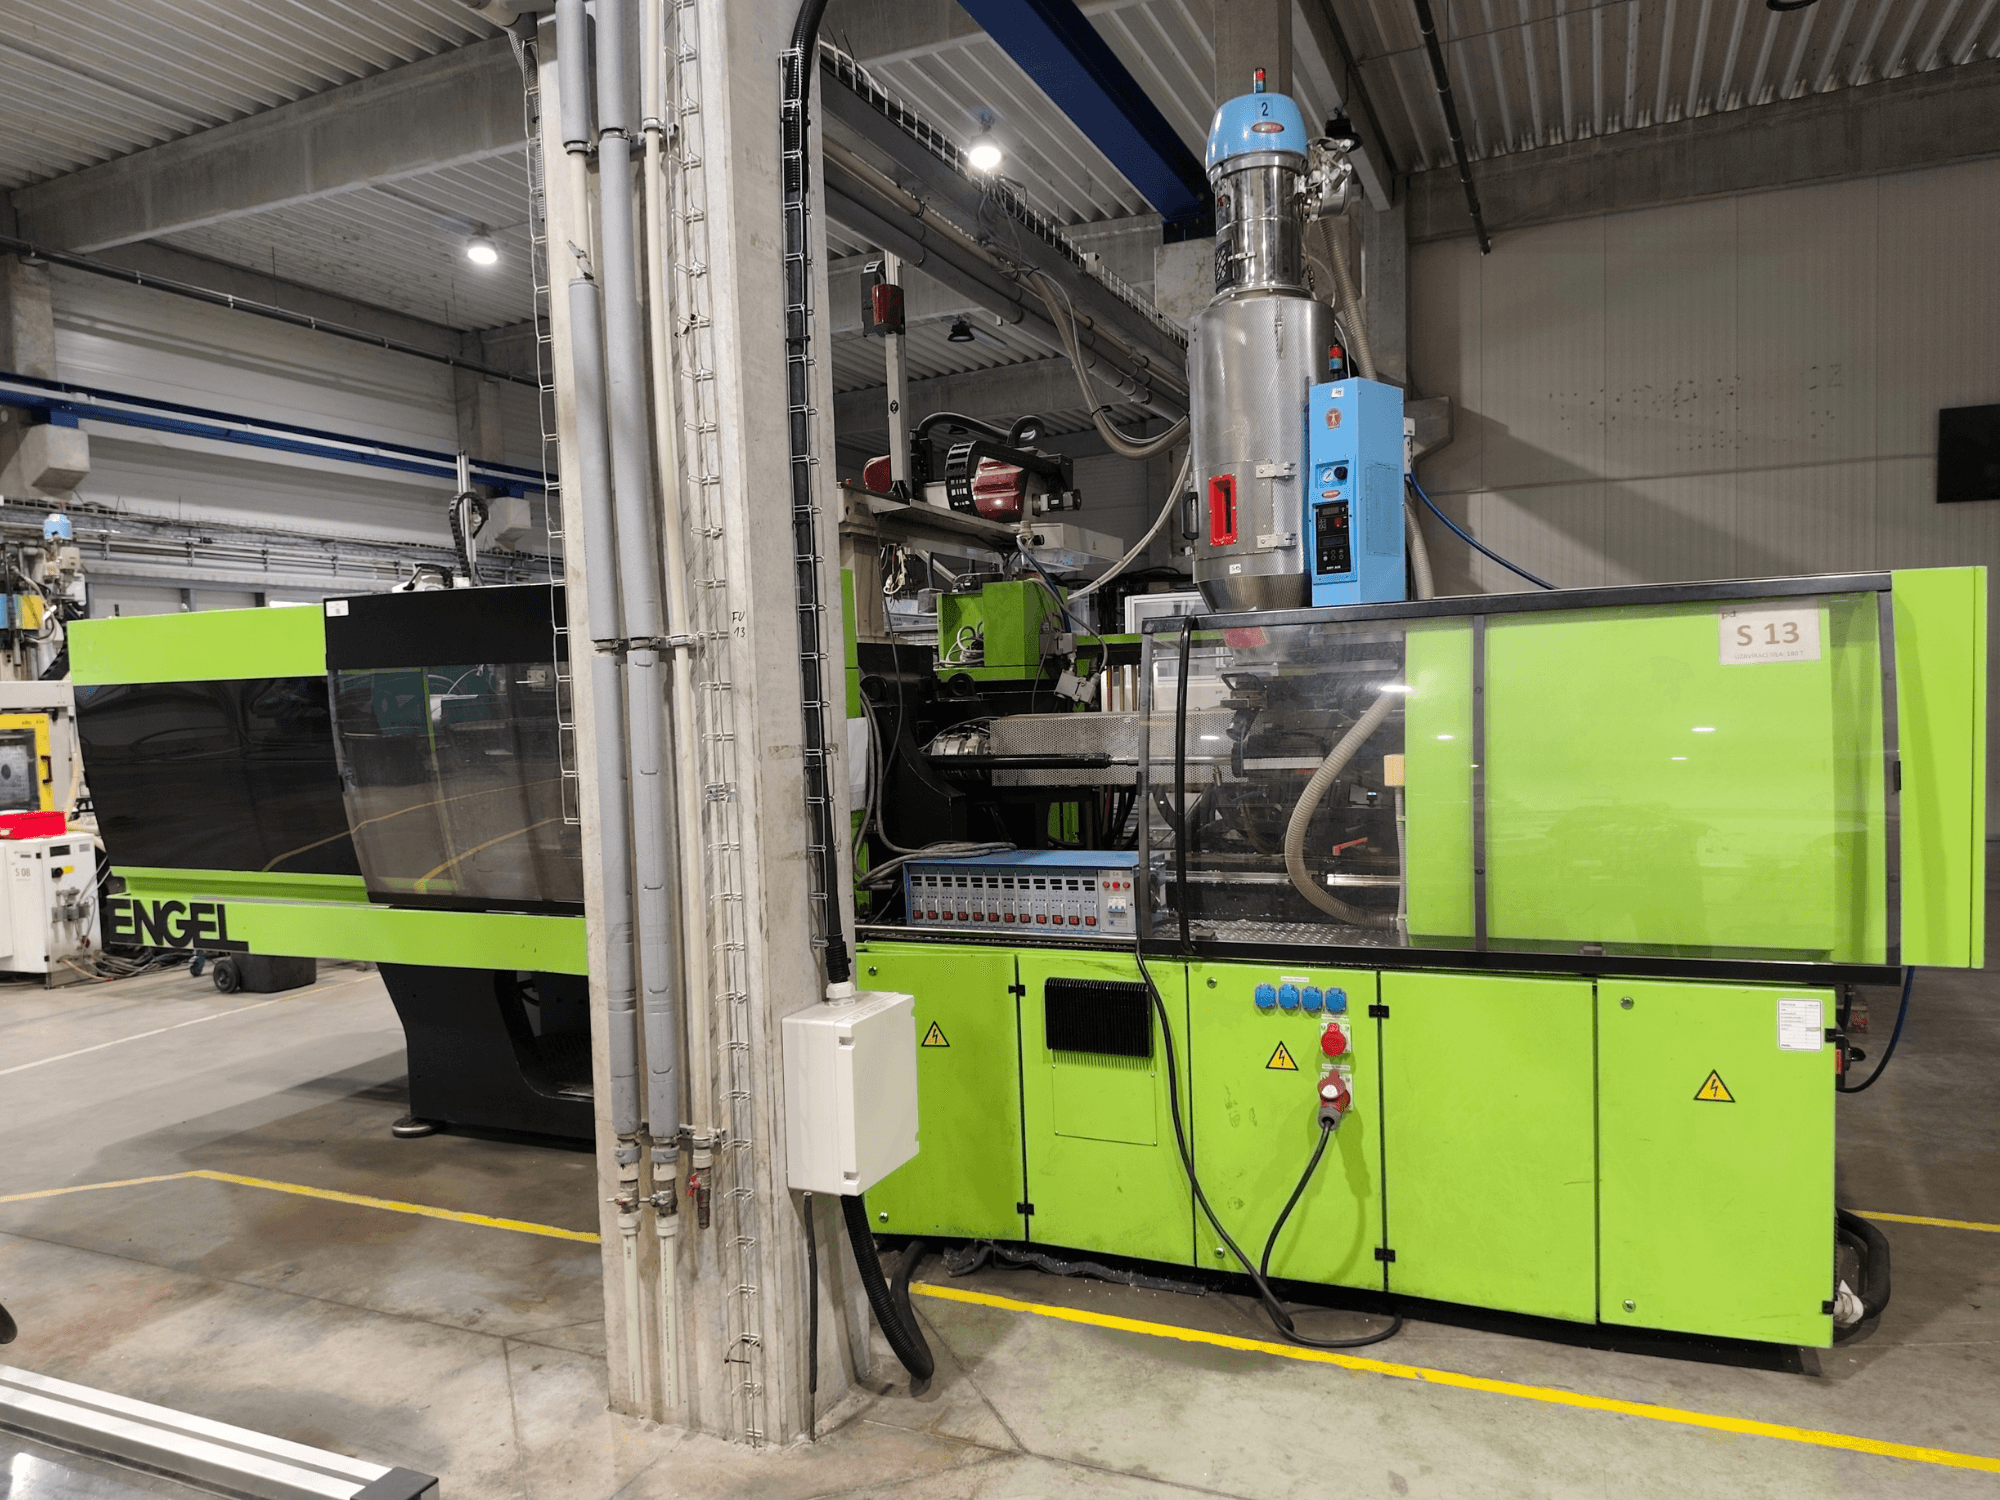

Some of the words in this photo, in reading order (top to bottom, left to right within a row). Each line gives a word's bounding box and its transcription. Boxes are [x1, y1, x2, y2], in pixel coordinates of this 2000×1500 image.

[1261, 101, 1269, 116] 2
[732, 611, 746, 624] FU
[733, 626, 746, 638] 13
[1737, 624, 1753, 647] S
[1764, 621, 1800, 646] 13
[15, 867, 20, 877] S
[21, 867, 31, 877] 08
[106, 899, 249, 952] ENGEL
